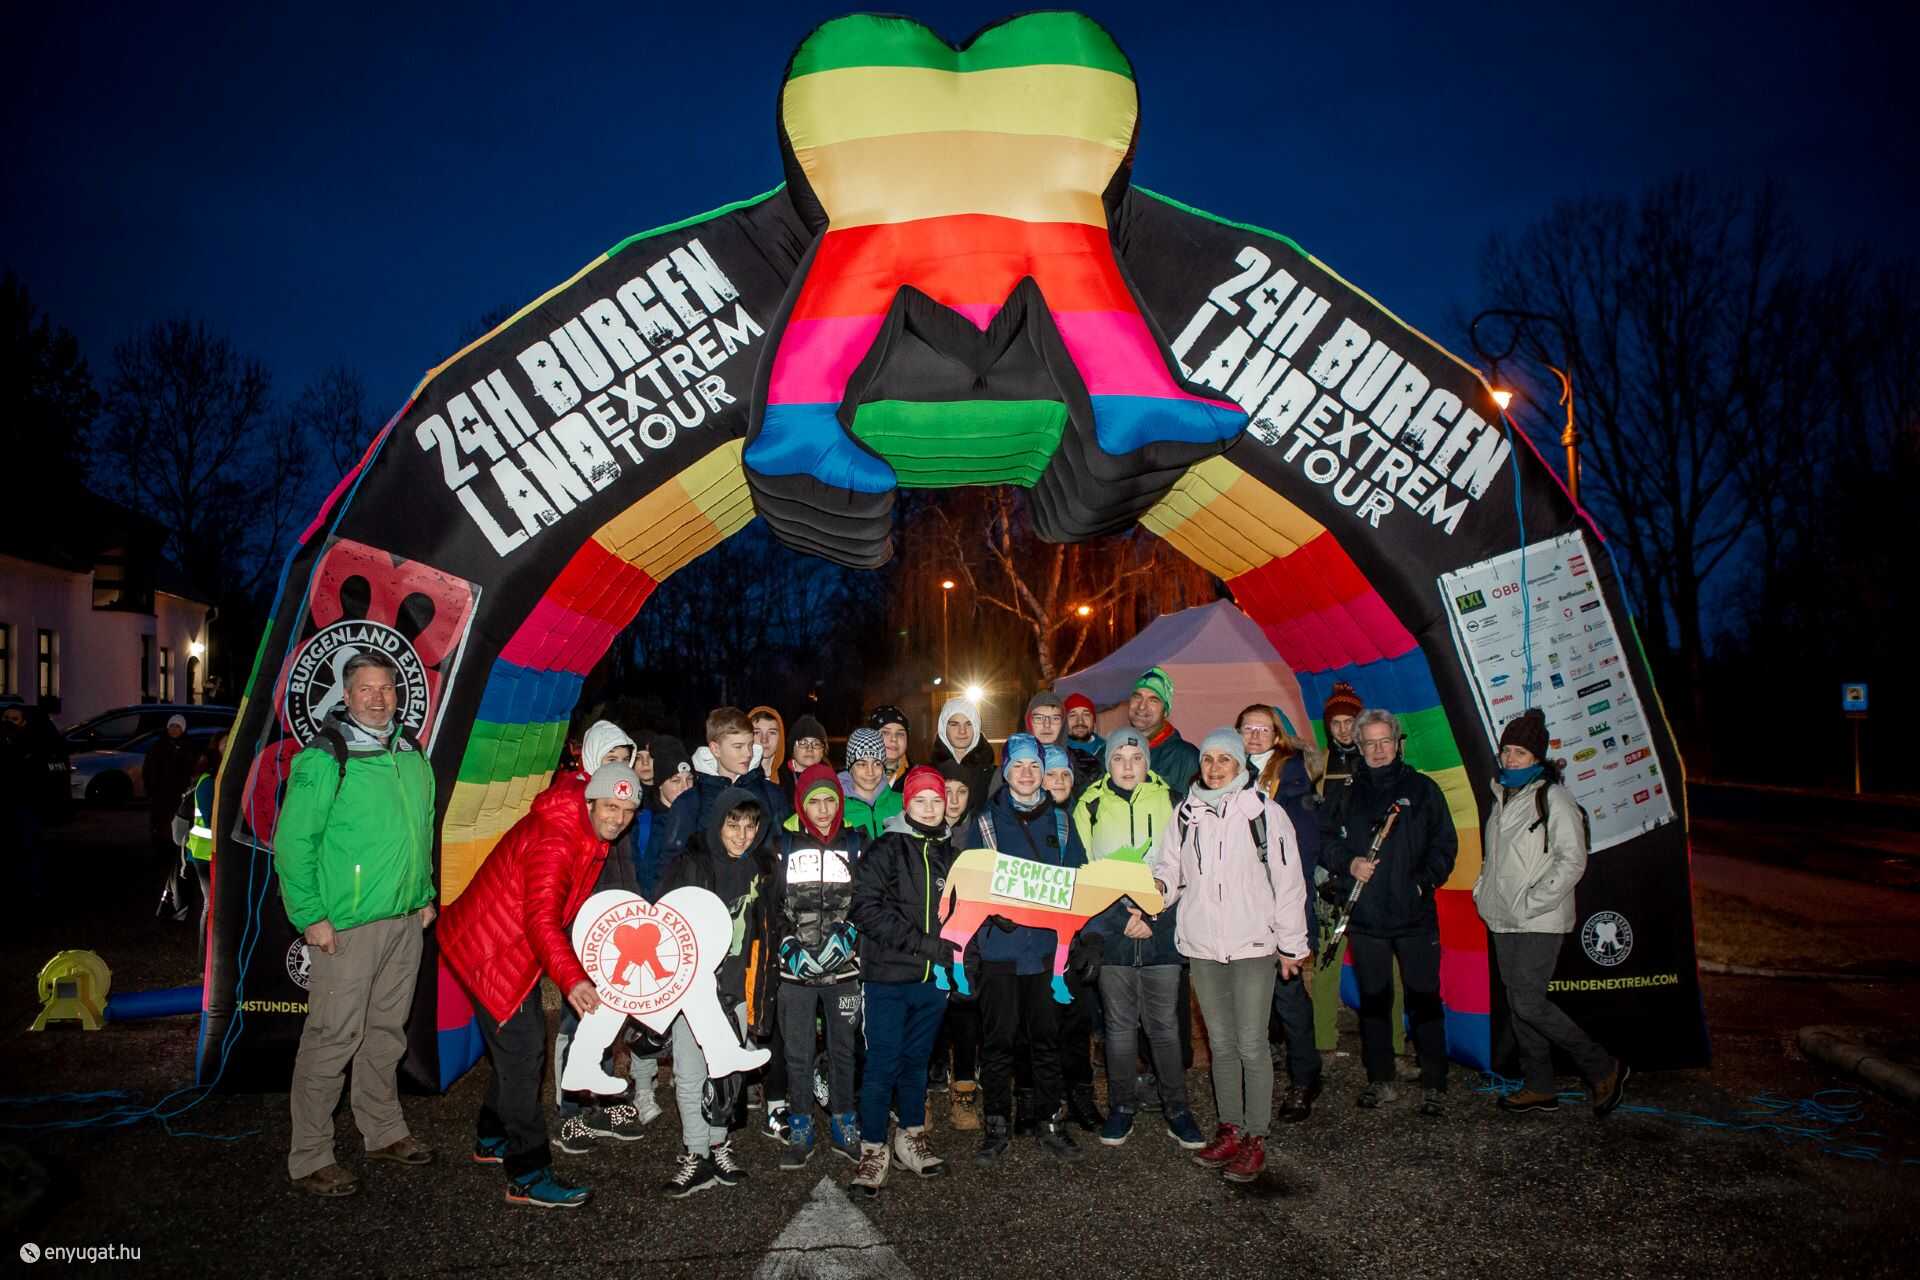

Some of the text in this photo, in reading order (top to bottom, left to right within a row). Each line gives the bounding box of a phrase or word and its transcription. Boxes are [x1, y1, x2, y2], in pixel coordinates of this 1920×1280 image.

[415, 238, 740, 490] 24H BURGEN
[585, 303, 765, 437] EXTREM
[611, 375, 737, 465] TOUR
[1171, 300, 1317, 447] LAND
[1208, 246, 1511, 500] 24H BURGEN
[456, 412, 622, 557] LAND
[1284, 427, 1396, 529] TOUR
[1301, 394, 1469, 536] EXTREM
[1458, 592, 1483, 609] XXL
[291, 627, 426, 728] BURGENLAND EXTREM
[586, 904, 695, 972] BURGENLAND EXTREM
[600, 983, 682, 1010] LIVE LOVE MOVE
